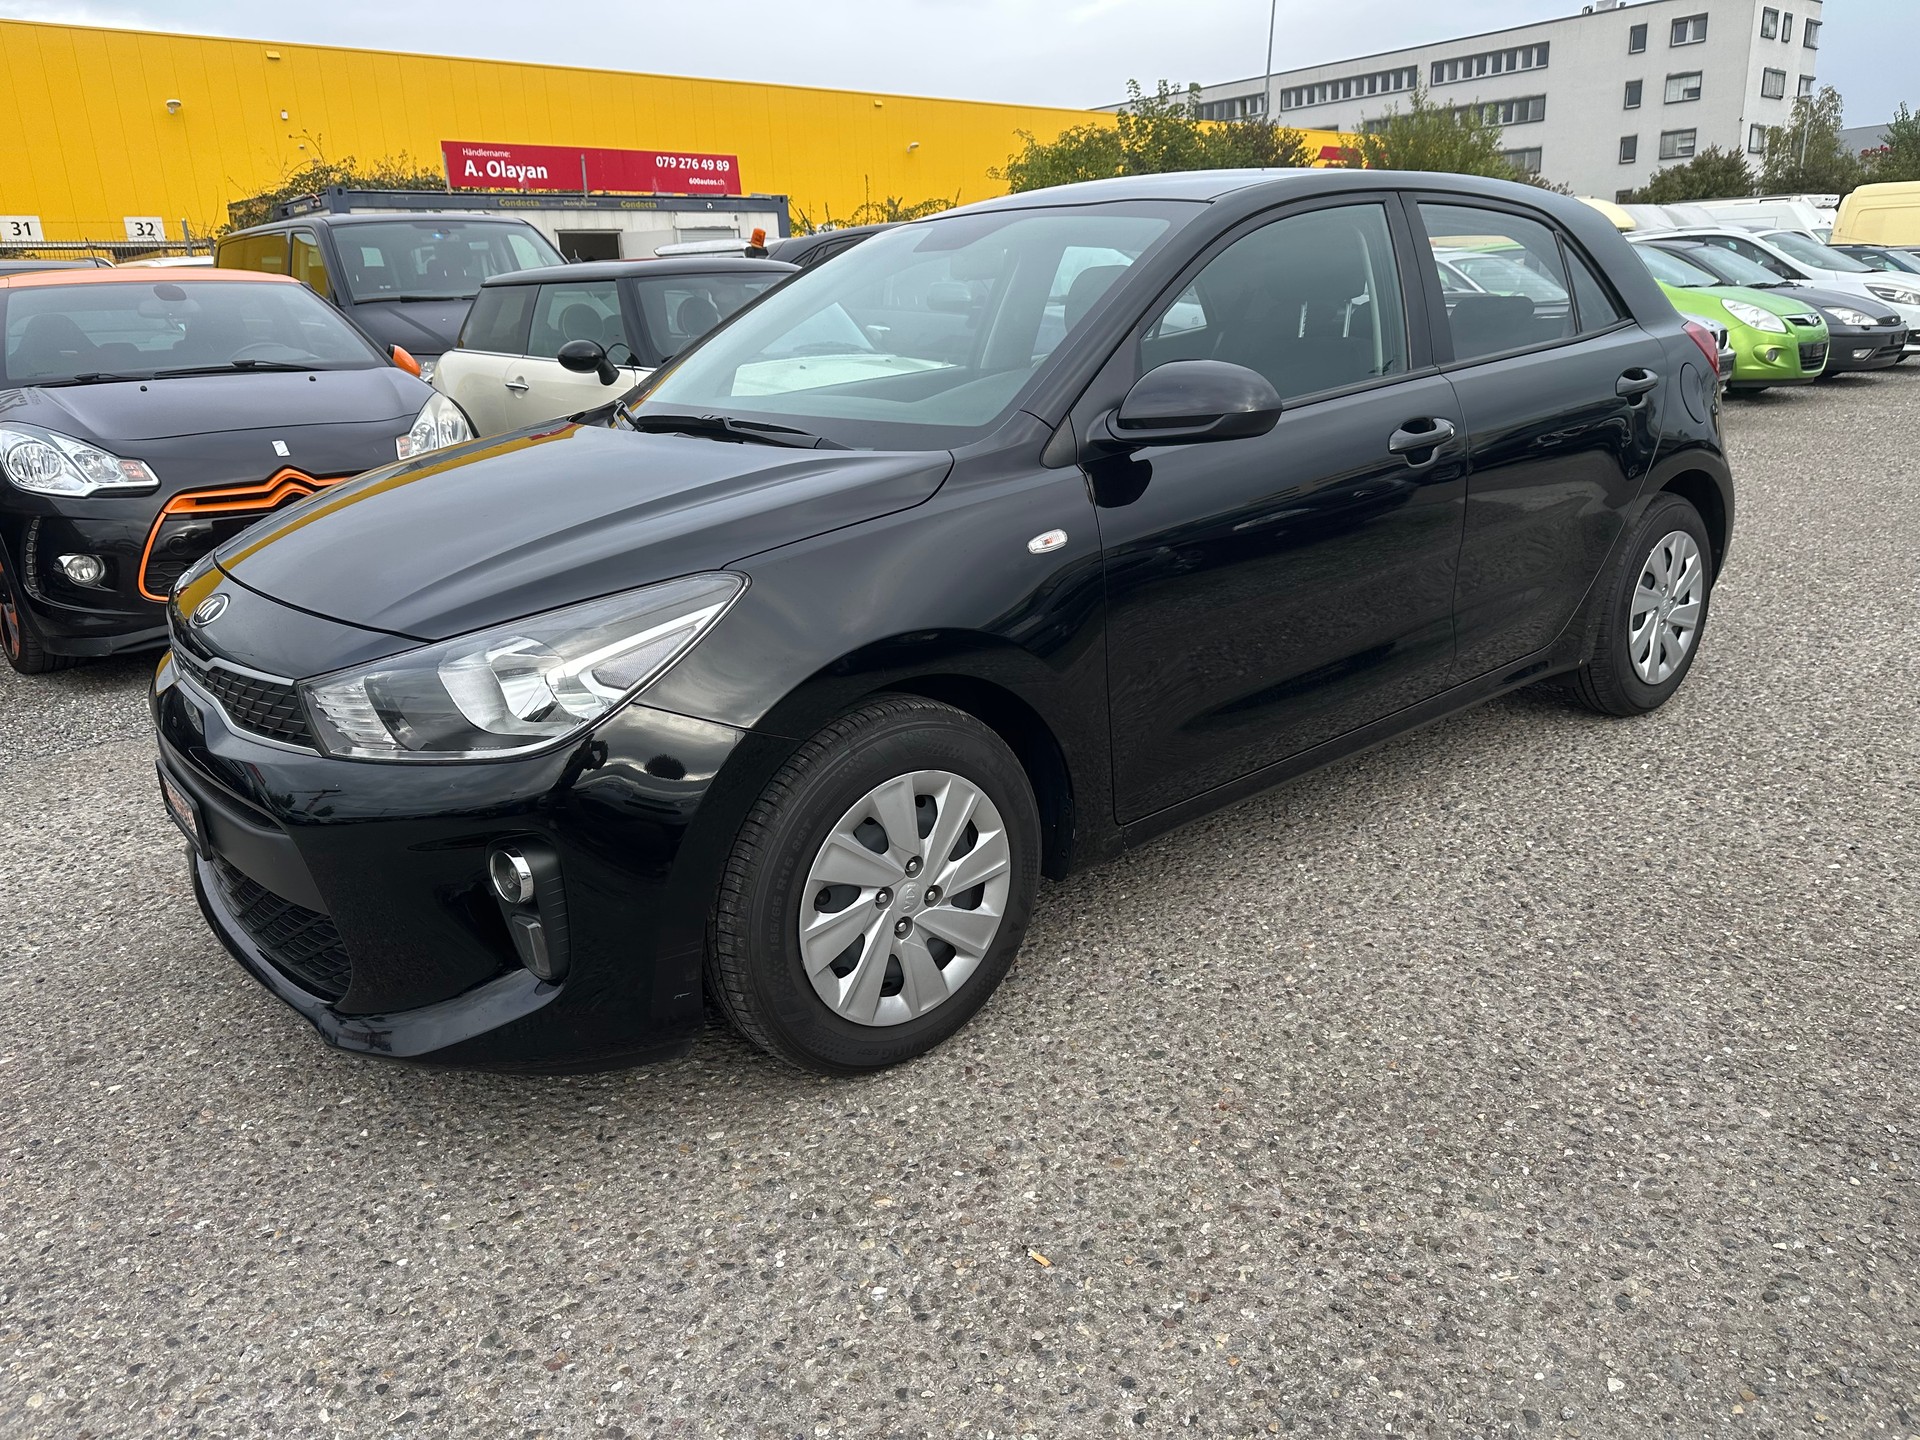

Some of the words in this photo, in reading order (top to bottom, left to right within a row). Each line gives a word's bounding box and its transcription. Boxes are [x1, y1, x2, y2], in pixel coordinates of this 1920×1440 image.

[462, 148, 511, 158] Händlername:
[656, 156, 677, 169] 079
[678, 157, 700, 170] 276
[700, 159, 715, 171] 49
[716, 160, 730, 172] 89
[464, 159, 483, 177] A.
[486, 160, 548, 182] Olayan
[688, 177, 725, 186] 600autos.ch
[499, 199, 540, 207] Condecta
[620, 200, 657, 208] Condecta
[10, 221, 33, 237] 31
[134, 222, 156, 237] 32
